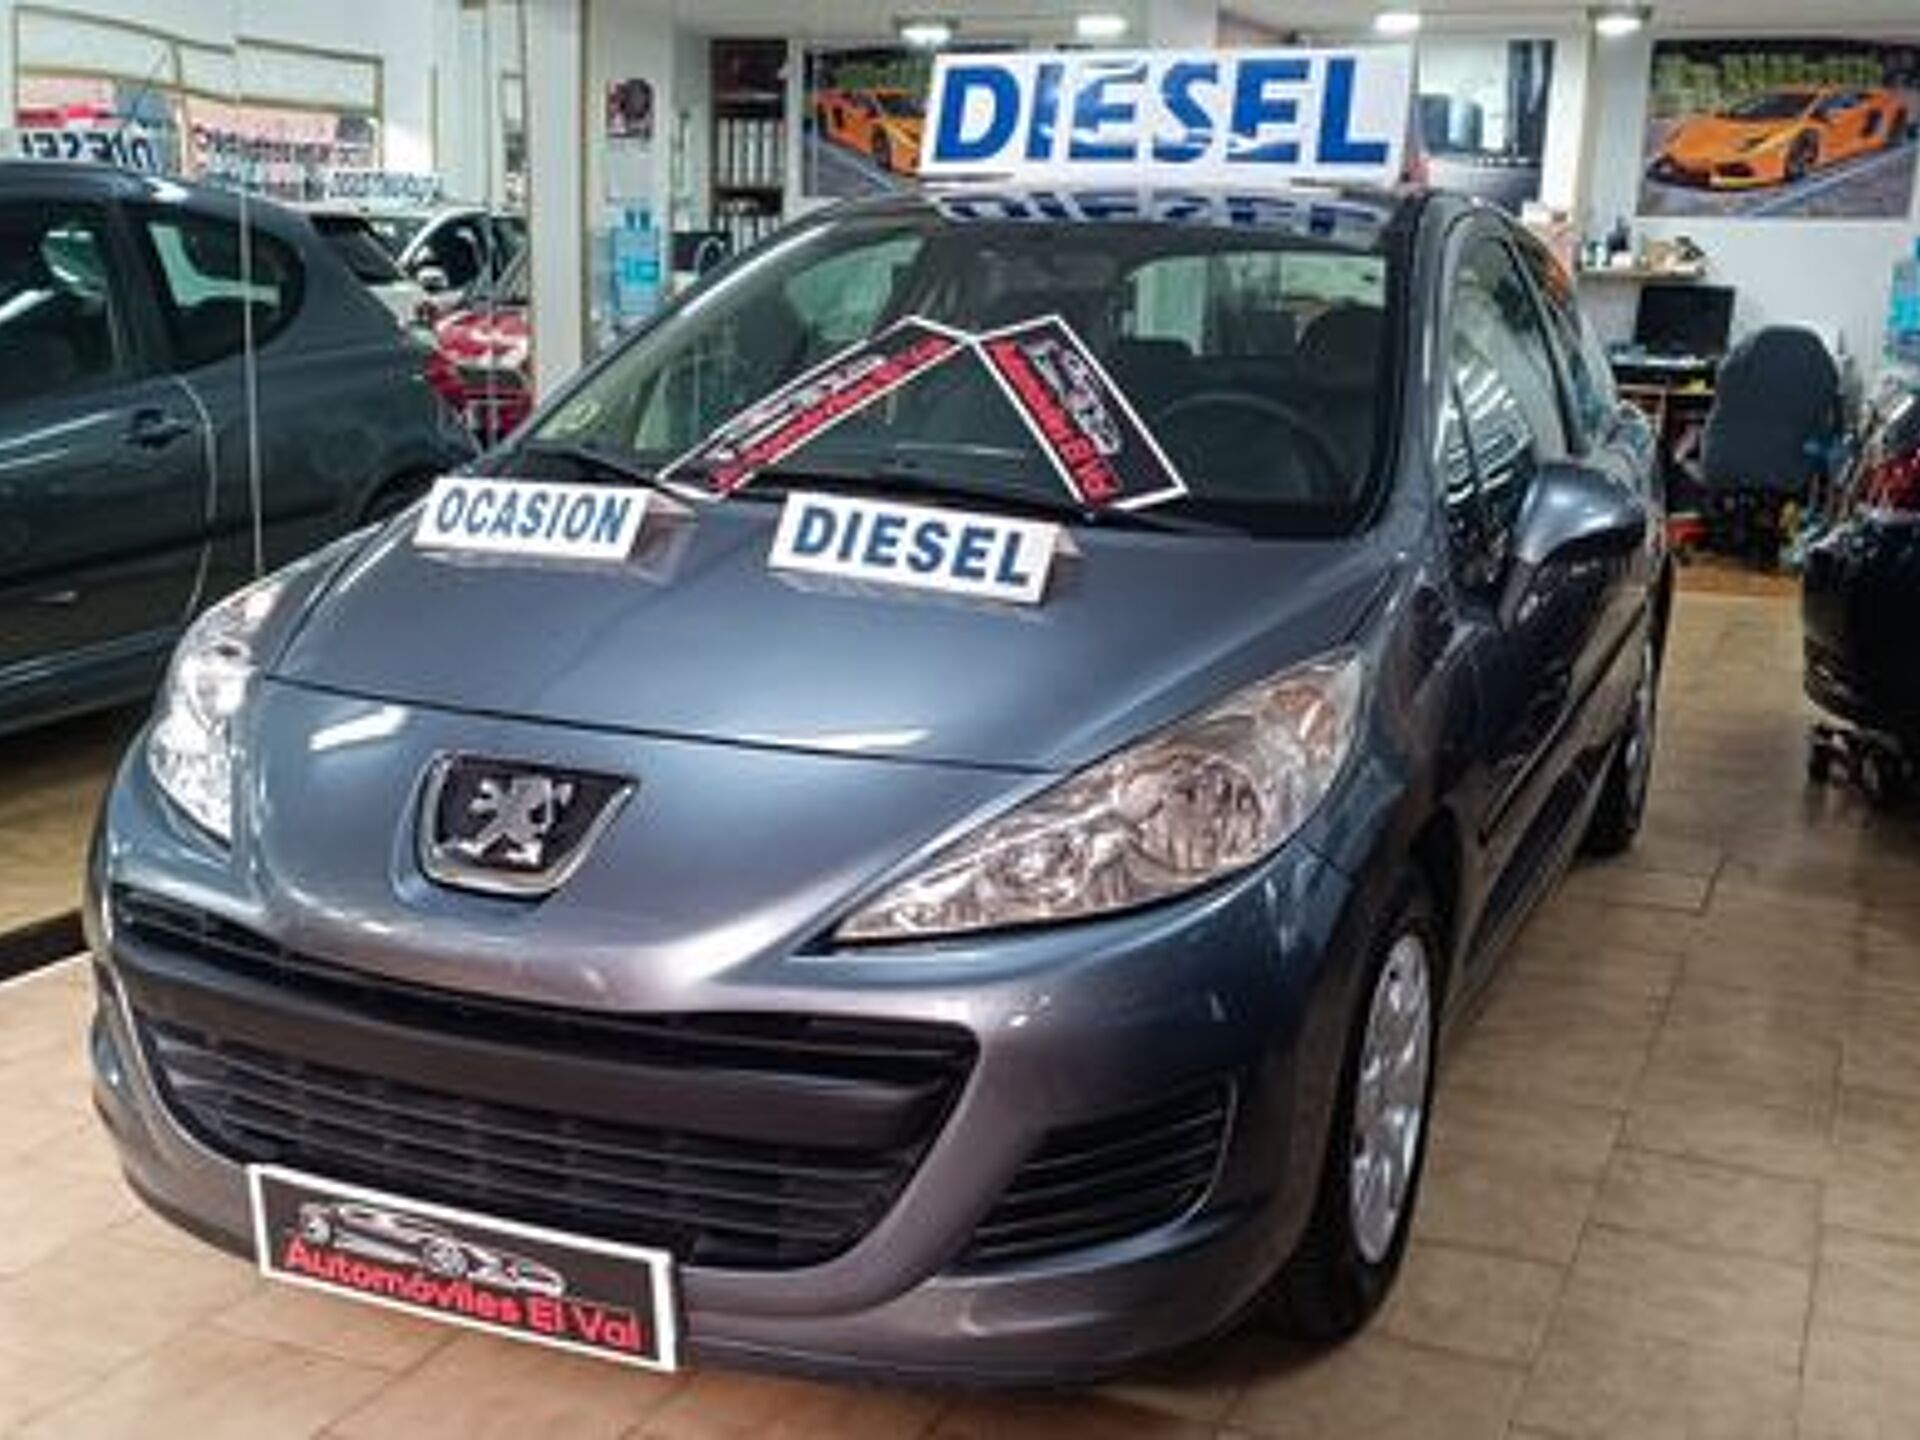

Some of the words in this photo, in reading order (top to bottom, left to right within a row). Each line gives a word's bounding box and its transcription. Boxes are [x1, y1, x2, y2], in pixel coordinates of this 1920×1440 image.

[933, 56, 1392, 166] DIESEL
[435, 486, 632, 544] OCASION
[791, 505, 1029, 587] DIESEL
[528, 1296, 564, 1333] El
[571, 1305, 642, 1351] Val
